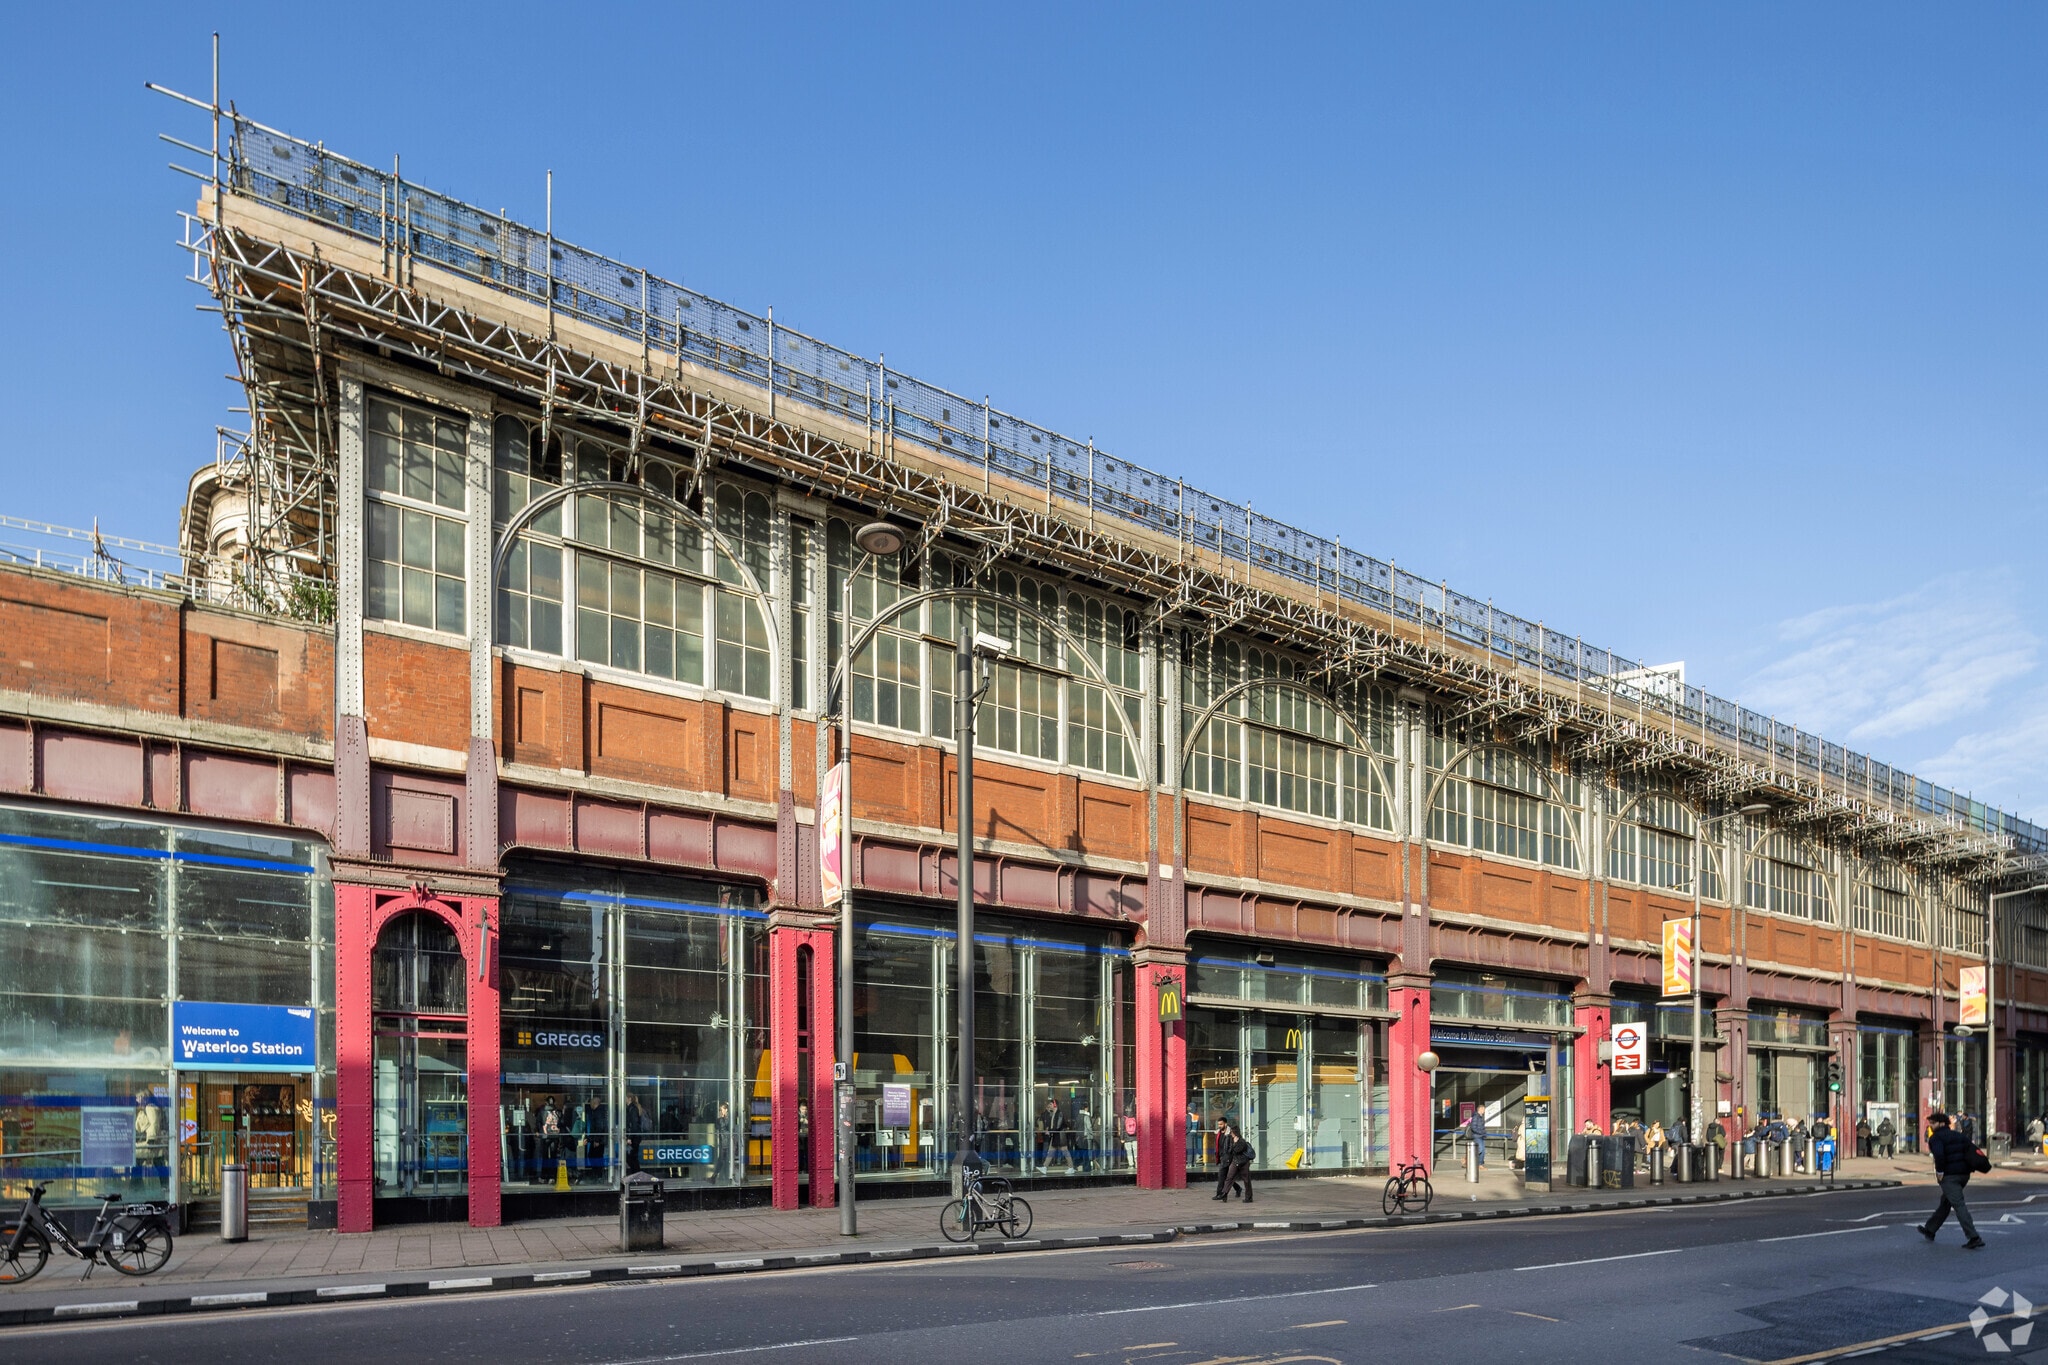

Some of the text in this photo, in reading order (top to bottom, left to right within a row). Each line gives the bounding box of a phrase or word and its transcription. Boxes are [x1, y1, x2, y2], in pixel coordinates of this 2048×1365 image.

[182, 1025, 239, 1036] Welcome to
[1431, 1029, 1516, 1043] Welcome to Waterloo Station
[535, 1032, 601, 1047] GREGGS
[182, 1039, 302, 1055] Waterloo Station
[1215, 1070, 1229, 1085] FCB
[656, 1148, 710, 1160] GREGGS
